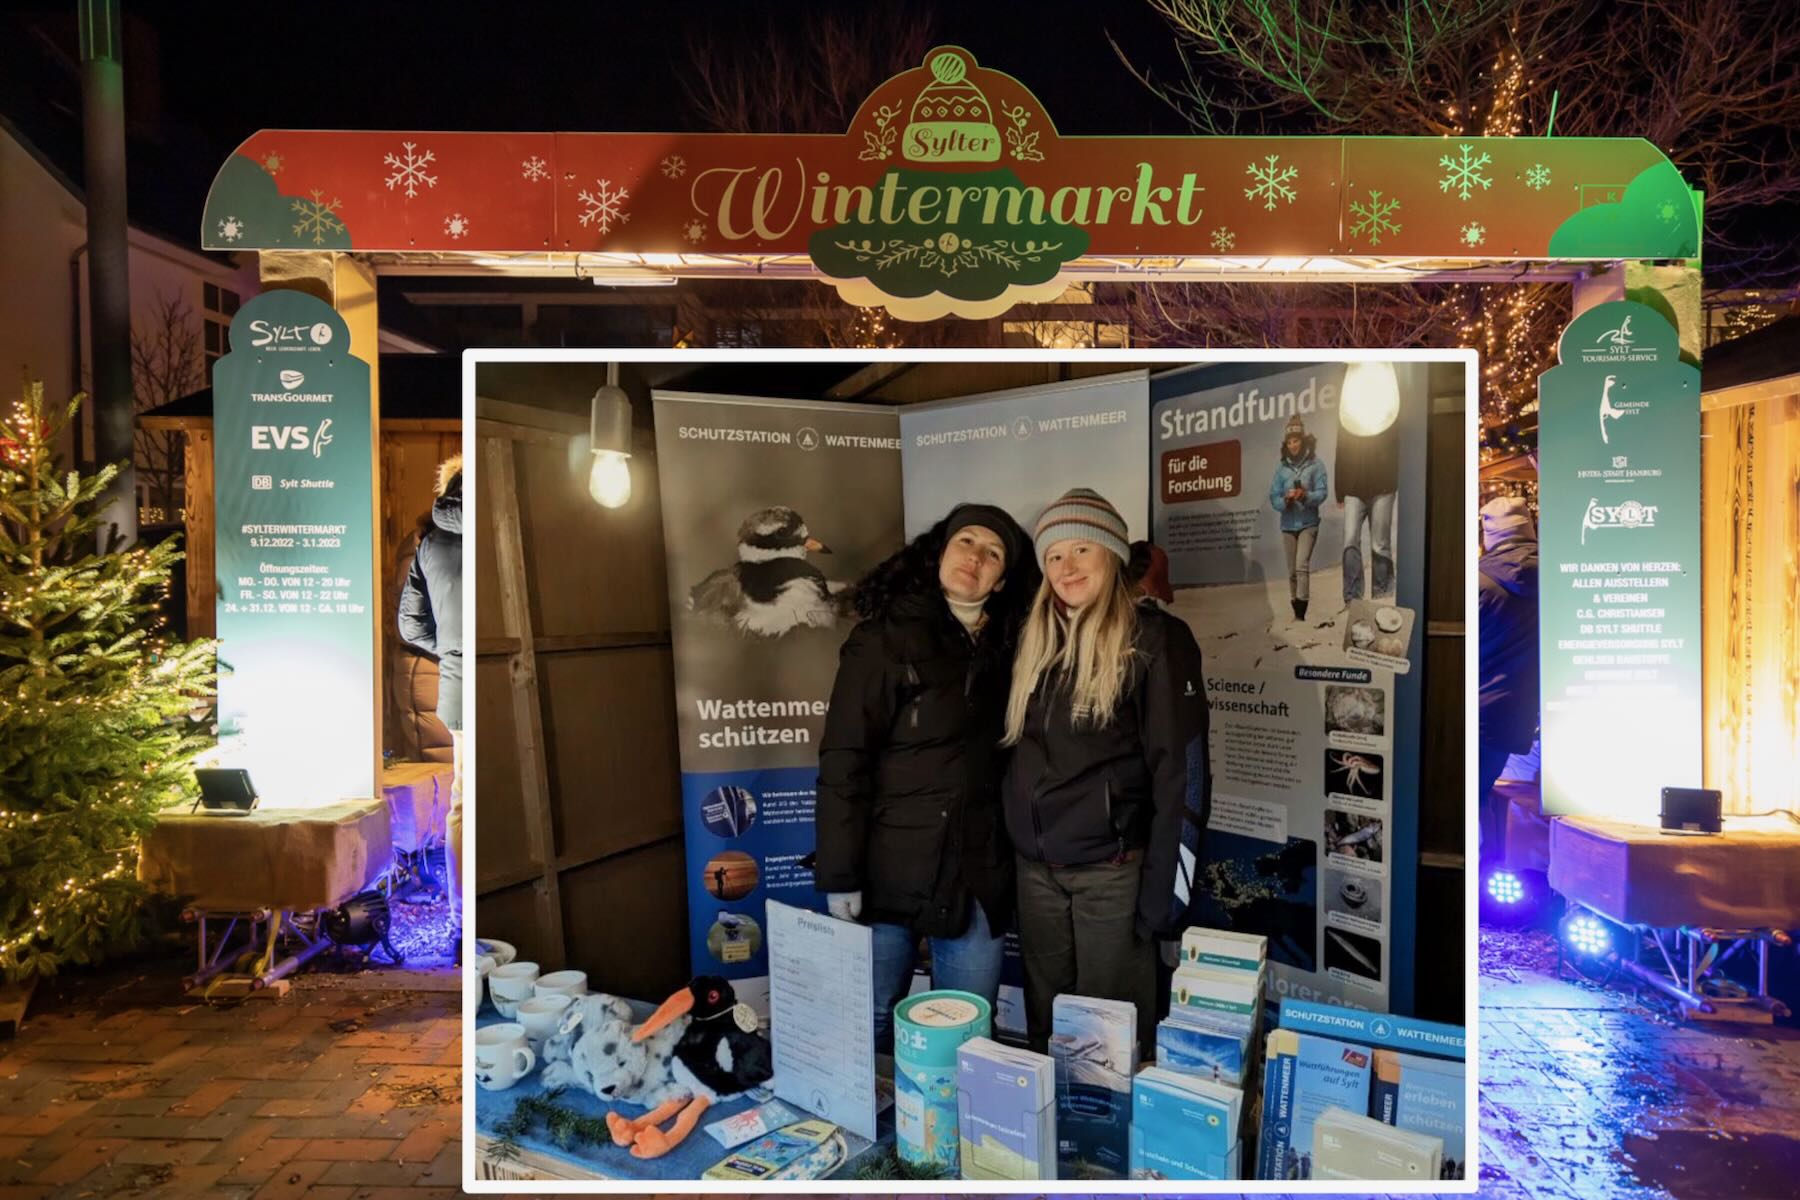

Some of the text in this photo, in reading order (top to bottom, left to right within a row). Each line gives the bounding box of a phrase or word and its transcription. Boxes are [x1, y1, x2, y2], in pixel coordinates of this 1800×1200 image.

[911, 128, 996, 158] Sylter
[691, 158, 1206, 241] Wintermarkt
[1582, 354, 1658, 363] TOURISMUS-SERVICE
[1609, 345, 1630, 354] SYLT
[1160, 377, 1337, 440] Strandfunde
[251, 425, 310, 450] EVS
[916, 410, 1128, 447] SCHUTZSTATION WATTENMEER
[679, 427, 902, 450] SCHUTZSTATION WATTENMEE
[1168, 456, 1208, 475] für die
[253, 476, 272, 489] DB
[280, 479, 335, 489] Sylt Shuttle
[1168, 474, 1233, 494] Forschung
[241, 524, 347, 535] #SYLTERWINTERMARKT
[250, 537, 294, 548] 9.12.2022
[302, 537, 341, 548] 3.1.2023
[259, 562, 329, 576] Öffnungszeiten:
[1560, 562, 1579, 573] WIR
[1580, 562, 1619, 573] DANKEN
[1620, 561, 1640, 572] VON
[238, 577, 256, 587] MO.
[264, 577, 279, 587] DO.
[281, 577, 301, 587] VON
[303, 577, 314, 587] 12
[321, 577, 334, 587] 20
[335, 577, 352, 587] Uhr
[1572, 577, 1669, 588] ALLEN AUSSTELLERN
[240, 589, 255, 600] FR.
[262, 589, 278, 600] SO.
[279, 589, 299, 600] VON
[301, 589, 313, 600] 12
[319, 589, 331, 600] 22
[333, 589, 349, 600] Uhr
[1298, 668, 1368, 681] Besondere Funde
[1207, 678, 1255, 694] Science
[696, 699, 830, 720] Wattenme
[699, 726, 810, 748] schützen
[1285, 1008, 1465, 1047] SCHUTZSTATION WATTENMEE
[1299, 1060, 1361, 1079] Wattführungen
[1279, 1057, 1292, 1119] WATTENMEER
[1323, 1075, 1360, 1089] auf Sylt
[1404, 1091, 1457, 1111] erleben
[1274, 1141, 1285, 1180] STATION
